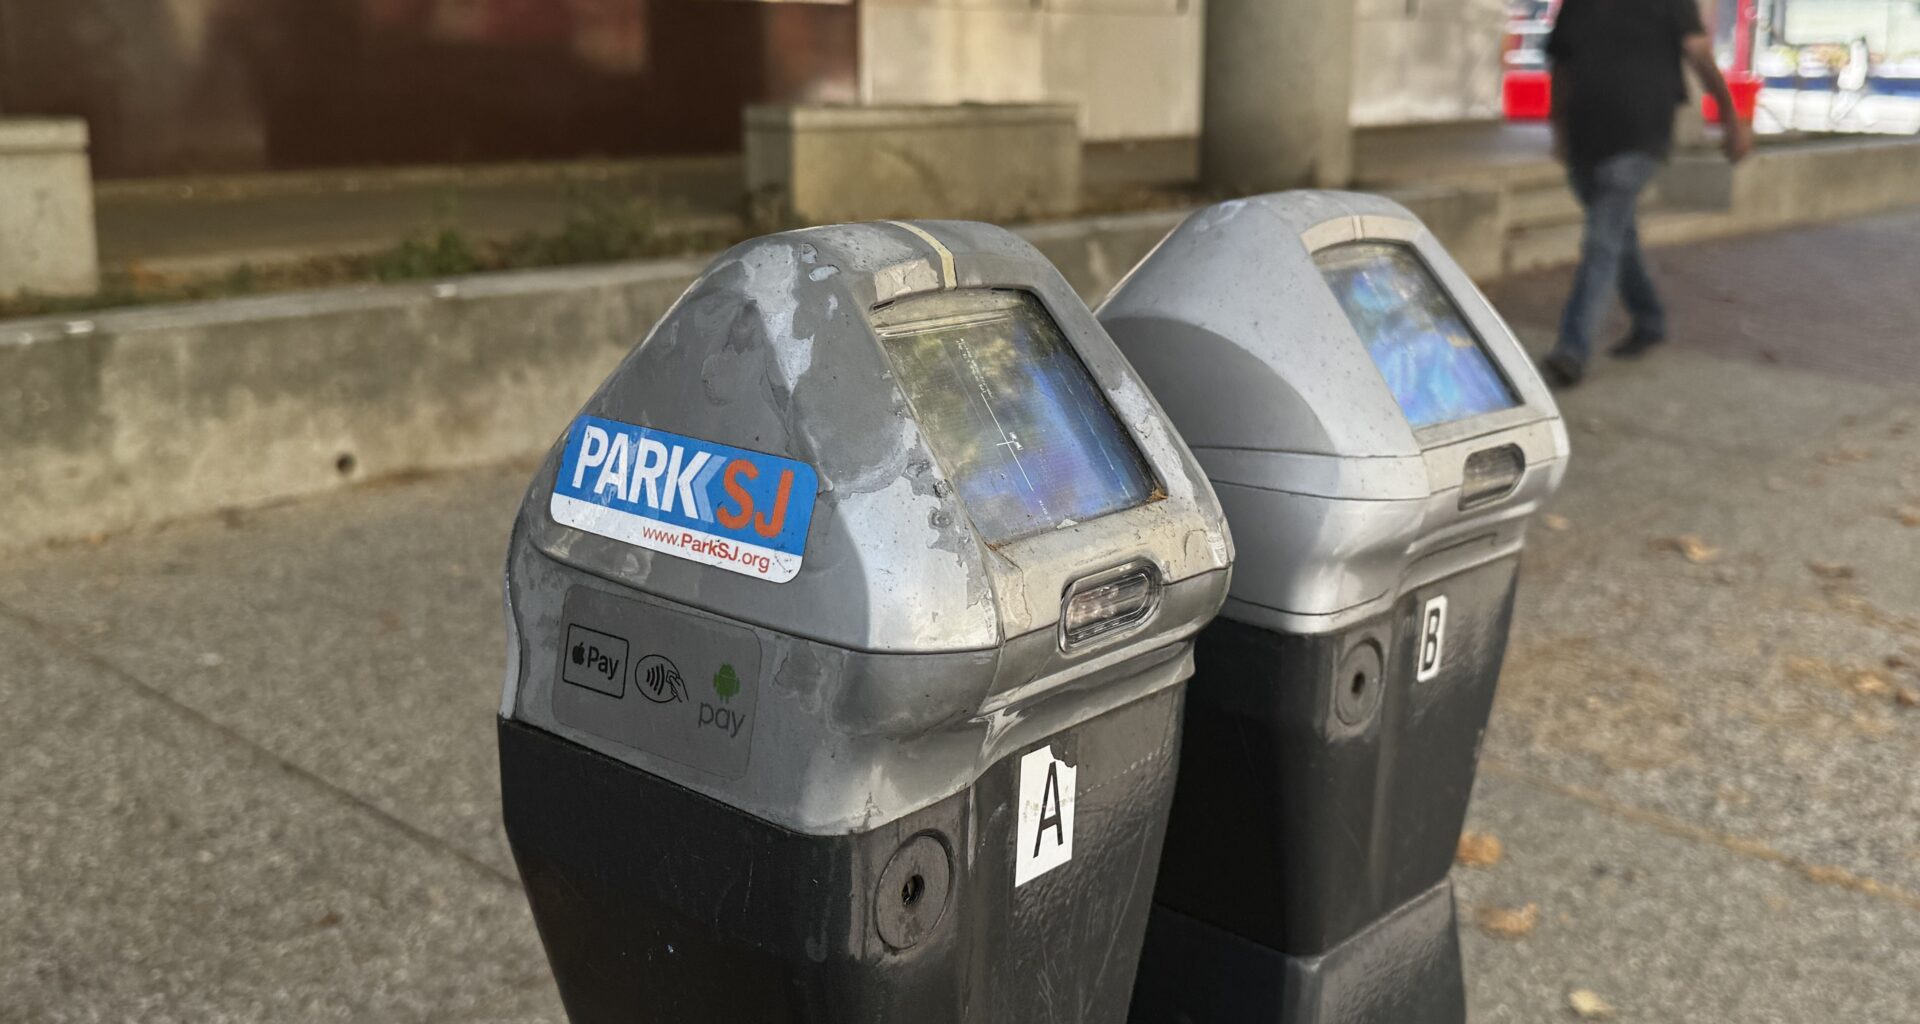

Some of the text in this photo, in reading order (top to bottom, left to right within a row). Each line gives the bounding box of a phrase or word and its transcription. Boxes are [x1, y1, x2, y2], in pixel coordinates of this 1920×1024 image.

[572, 425, 794, 538] PARK SJ
[642, 526, 770, 573] www.ParkSJ.org
[587, 646, 619, 680] Pay
[1421, 607, 1441, 672] B
[698, 702, 745, 738] pay
[1033, 761, 1063, 858] A
